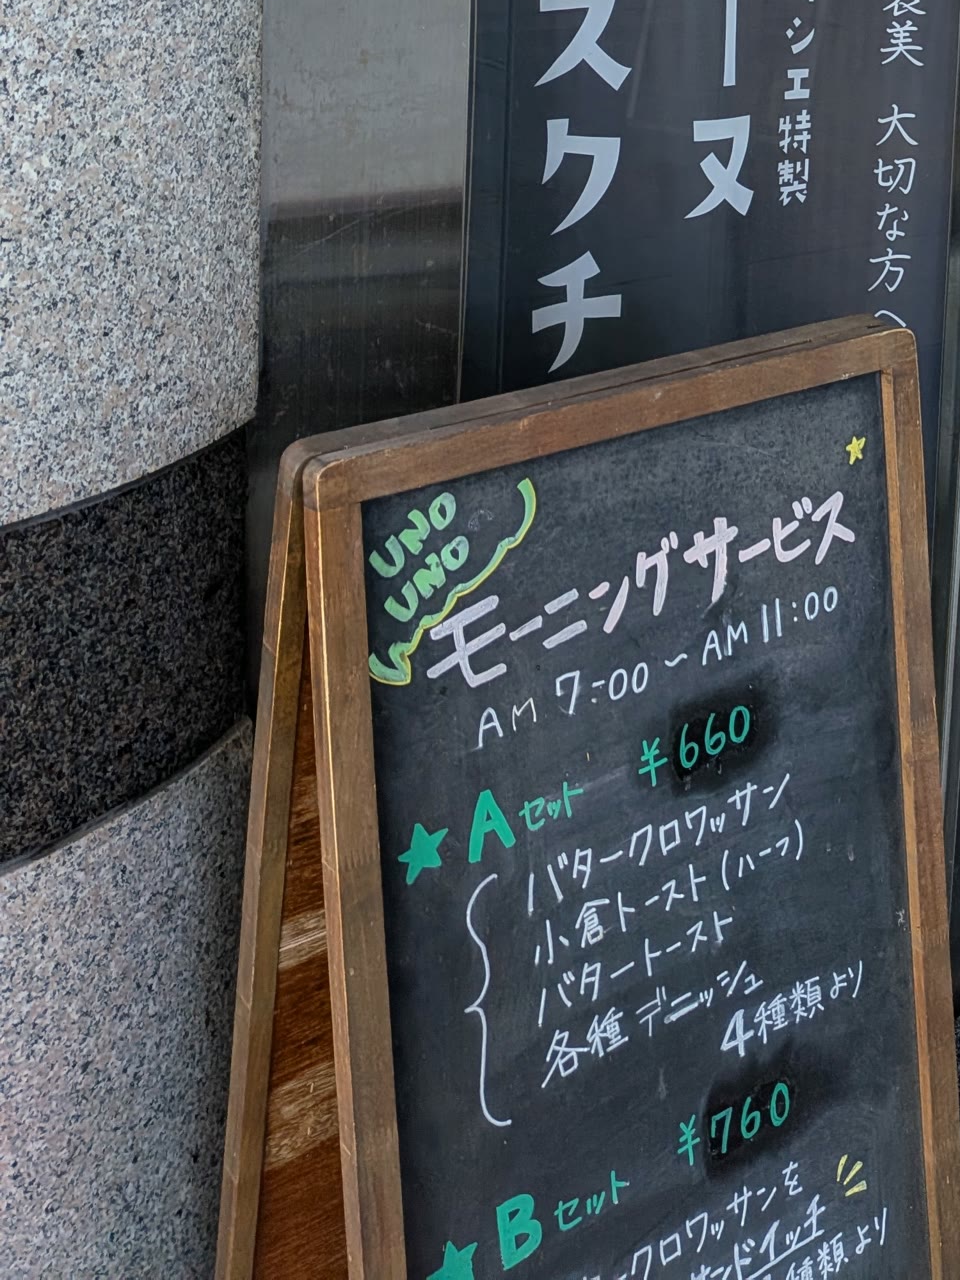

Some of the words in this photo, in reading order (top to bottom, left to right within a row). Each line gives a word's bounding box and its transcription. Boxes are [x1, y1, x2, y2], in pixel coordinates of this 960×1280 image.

[868, 104, 919, 327] 大切な方へ
[369, 492, 457, 578] UNO
[384, 535, 470, 622] UNO
[426, 491, 856, 687] モーニングサービス
[472, 697, 537, 751] AM
[555, 663, 649, 715] 7:00
[701, 621, 750, 666] AM
[760, 586, 839, 643] 11:00
[638, 706, 751, 787] ¥660
[527, 773, 790, 917] バタークロワッサン
[537, 912, 733, 1028] バタートースト
[541, 961, 764, 1088] 各種デニッシュ
[720, 961, 865, 1058] 4種類より
[677, 1082, 791, 1165] ¥760
